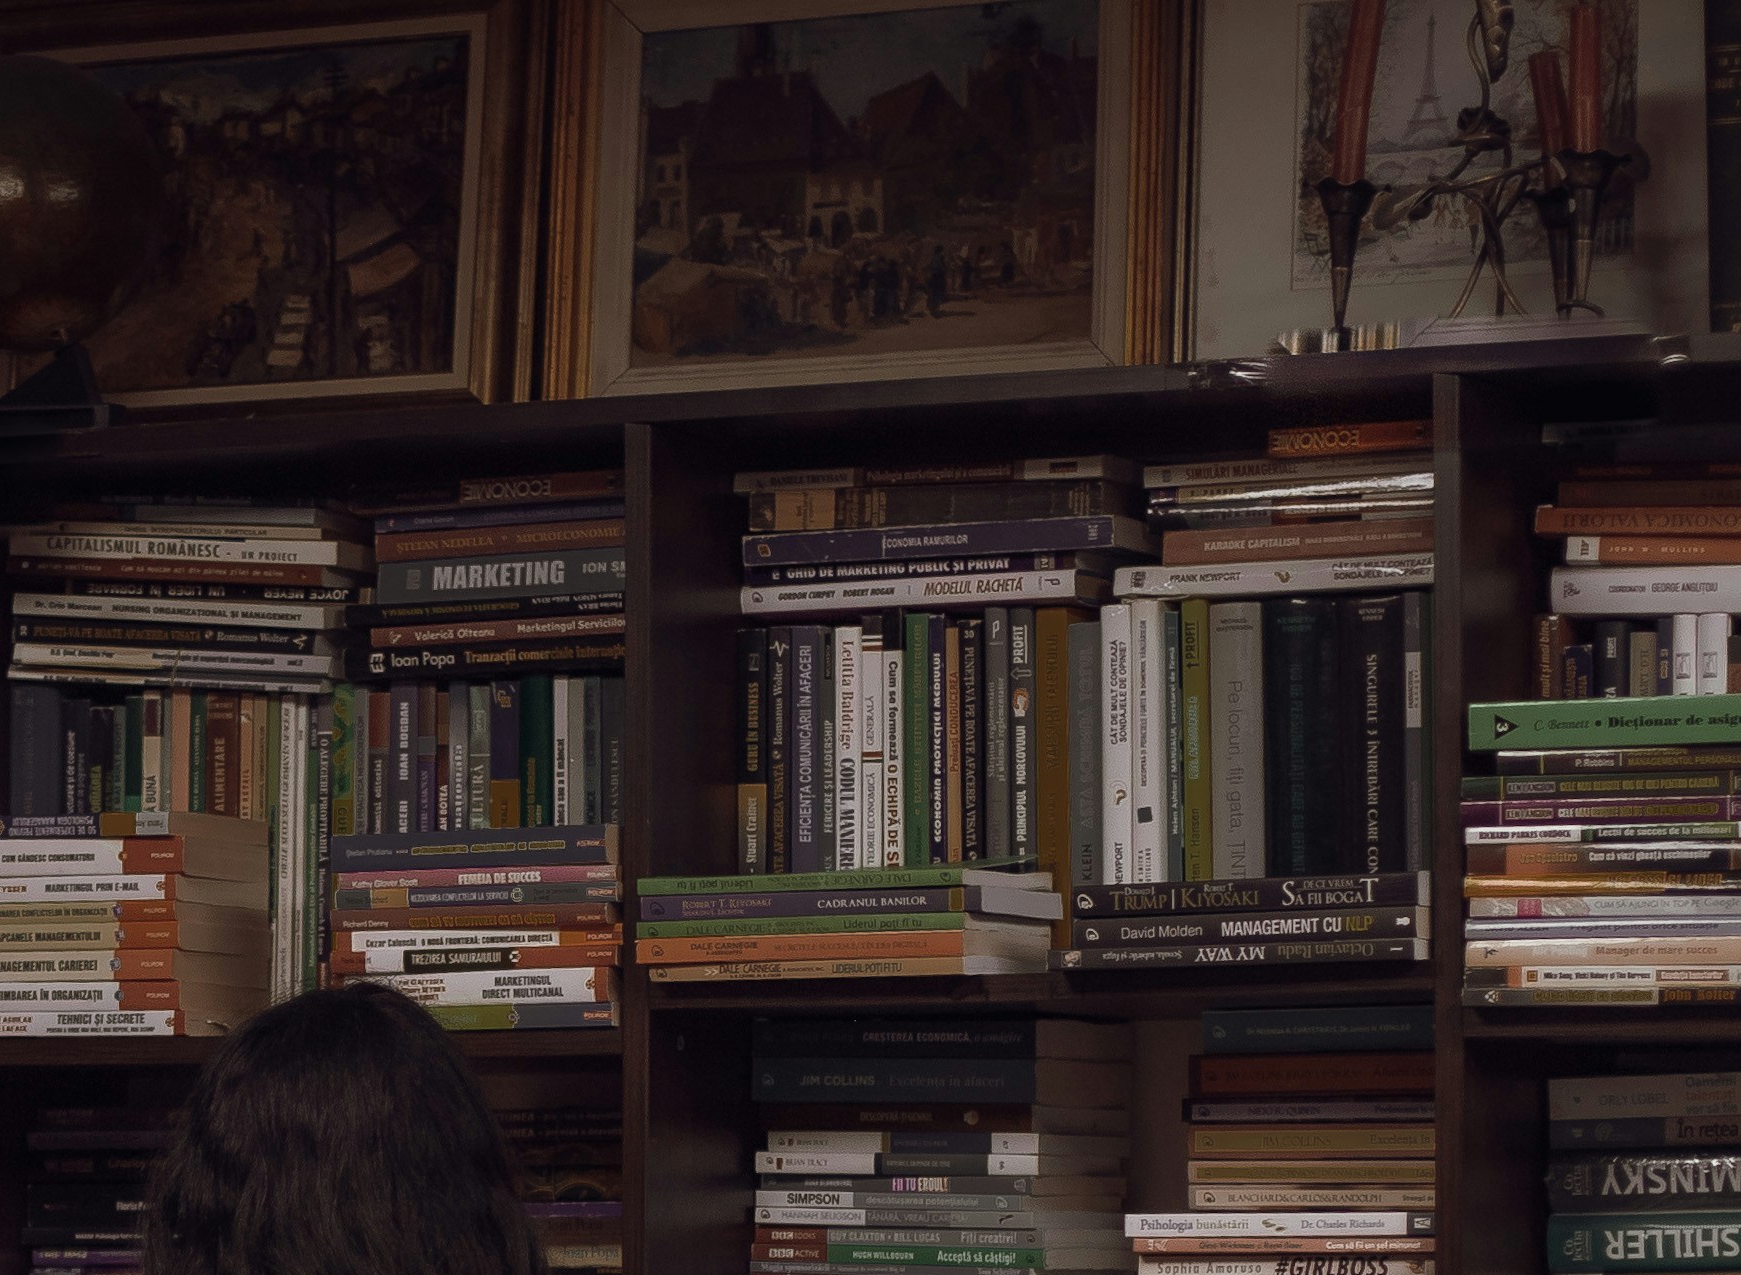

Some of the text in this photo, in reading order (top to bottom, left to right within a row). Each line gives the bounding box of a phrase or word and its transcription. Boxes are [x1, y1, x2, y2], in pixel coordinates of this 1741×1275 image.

[1273, 430, 1360, 450] ECONOMIE
[464, 480, 551, 500] ECONOMIE
[47, 537, 220, 558] CAPITALISMUL ROMÂNESC
[1204, 539, 1246, 551] KARAOKE
[1248, 537, 1300, 549] CAPITALISM
[433, 560, 606, 590] MARKETING ION
[787, 567, 815, 579] GHID
[819, 566, 833, 578] DE
[837, 562, 905, 577] MARKETING
[909, 560, 949, 573] PUBLIC
[968, 557, 1010, 571] PRIVAT
[310, 589, 349, 600] JOYCE
[924, 576, 1023, 596] MODELUL RACHETĂ
[1012, 626, 1024, 663] PROFIT
[391, 652, 454, 668] Ioan Popa
[1609, 714, 1703, 730] Dicționar de
[796, 645, 817, 842] EFICIENȚA COMUNICĂRII ÎN AFACERI
[839, 757, 855, 806] CODUL
[1015, 725, 1027, 841] PRINCIPIUL MORCOVULUI
[1081, 844, 1092, 881] KLEIN
[817, 895, 927, 910] CADRANUL BANILOR
[1110, 888, 1259, 911] TRUMP KIYOSAKI
[1121, 916, 1372, 939] David Molden MANAGEMENT CU NLP
[1195, 946, 1266, 962] MY WAY
[58, 960, 98, 971] CARIEREI
[494, 975, 551, 986] MARKETINGUL
[482, 988, 511, 999] DIRECT
[822, 1075, 875, 1087] COLLINS
[787, 1194, 840, 1205] SIMPSON
[1141, 1218, 1249, 1232] Psihologia bunăstării
[1605, 1226, 1740, 1260] SHILLER
[1158, 1262, 1200, 1275] Sophia
[1206, 1262, 1262, 1274] Amoruso
